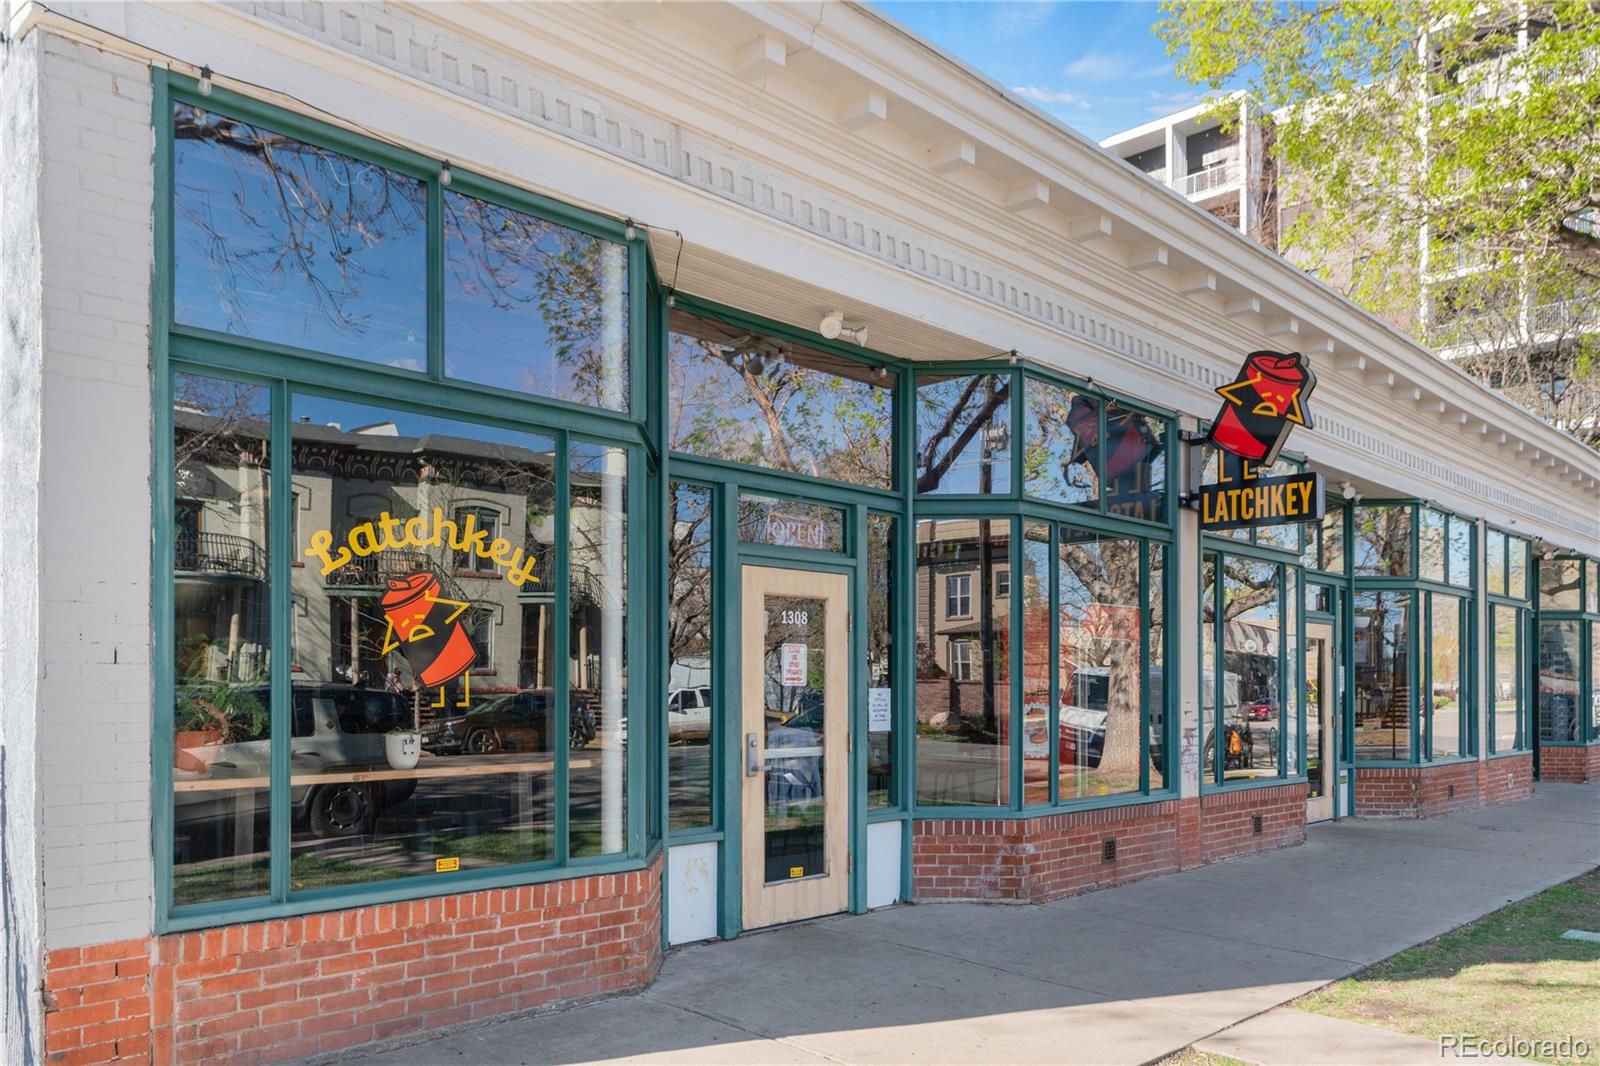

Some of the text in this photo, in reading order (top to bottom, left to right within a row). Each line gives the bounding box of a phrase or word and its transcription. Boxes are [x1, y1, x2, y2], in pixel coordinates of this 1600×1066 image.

[1203, 480, 1314, 524] LATCHKEY
[303, 506, 541, 587] Latchkey
[770, 519, 820, 548] OPEN
[781, 610, 808, 625] 1308
